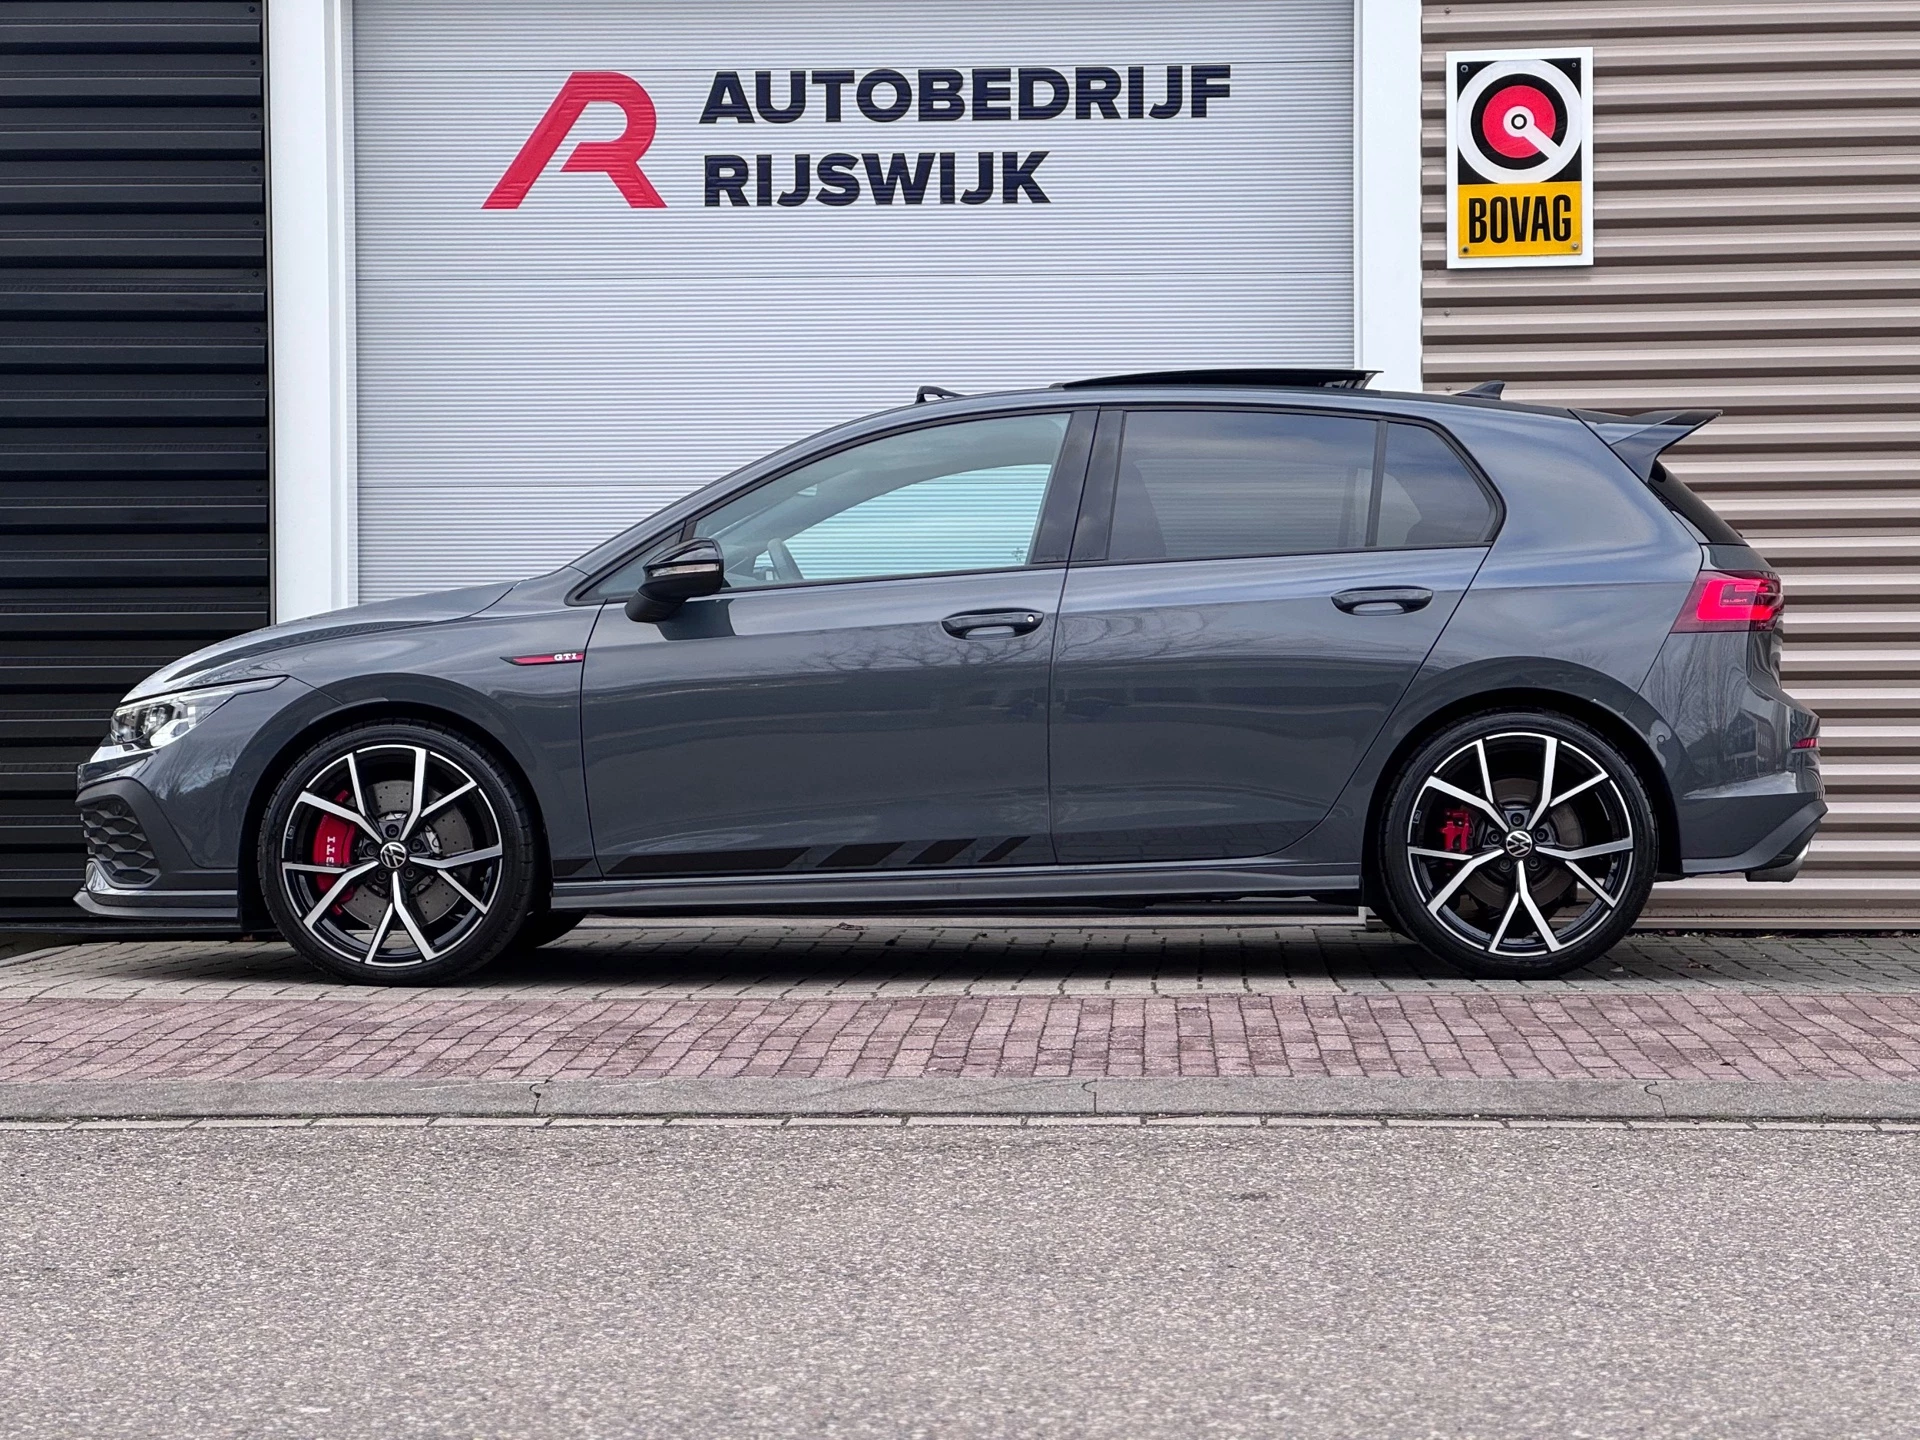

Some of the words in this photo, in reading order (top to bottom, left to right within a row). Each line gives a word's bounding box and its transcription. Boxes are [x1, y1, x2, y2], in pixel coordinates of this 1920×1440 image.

[699, 64, 1231, 124] AUTOBEDRIJF
[704, 151, 1051, 208] RIJSWIJK
[1468, 194, 1572, 244] BOVAG
[554, 652, 577, 662] GTI
